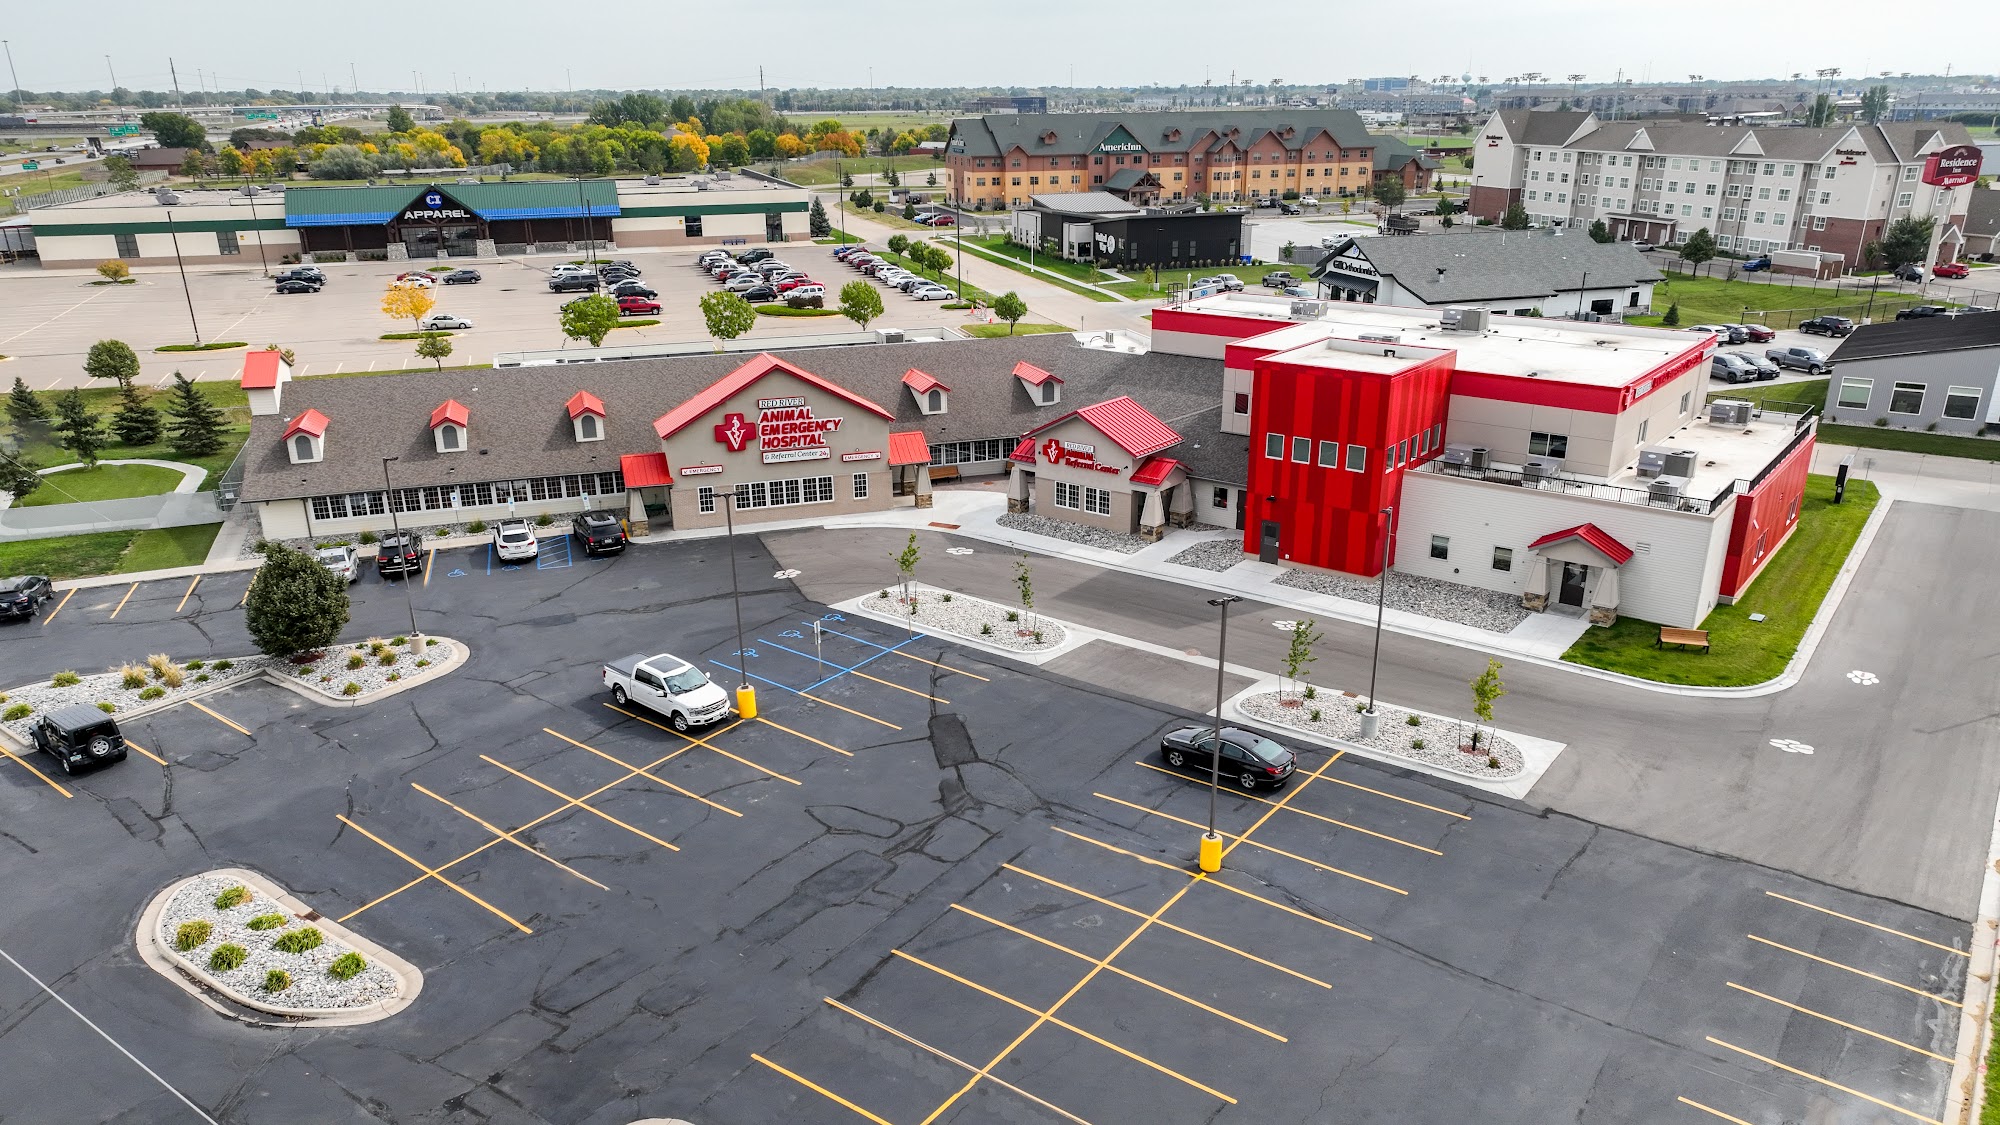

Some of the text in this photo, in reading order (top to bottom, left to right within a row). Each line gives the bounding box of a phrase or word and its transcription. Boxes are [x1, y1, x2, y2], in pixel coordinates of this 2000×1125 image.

[1099, 143, 1141, 151] AmericInn
[1940, 158, 1977, 168] Residence
[1941, 177, 1967, 185] Marriott
[426, 195, 441, 204] CI
[404, 210, 470, 219] APPAREL
[761, 398, 803, 408] RED RIVER
[759, 408, 814, 423] ANIMAL
[760, 418, 842, 436] EMERGENCY
[761, 433, 825, 449] HOSPITAL
[771, 451, 797, 460] Referral
[797, 450, 818, 458] Center
[1065, 457, 1121, 475] Referral Center
